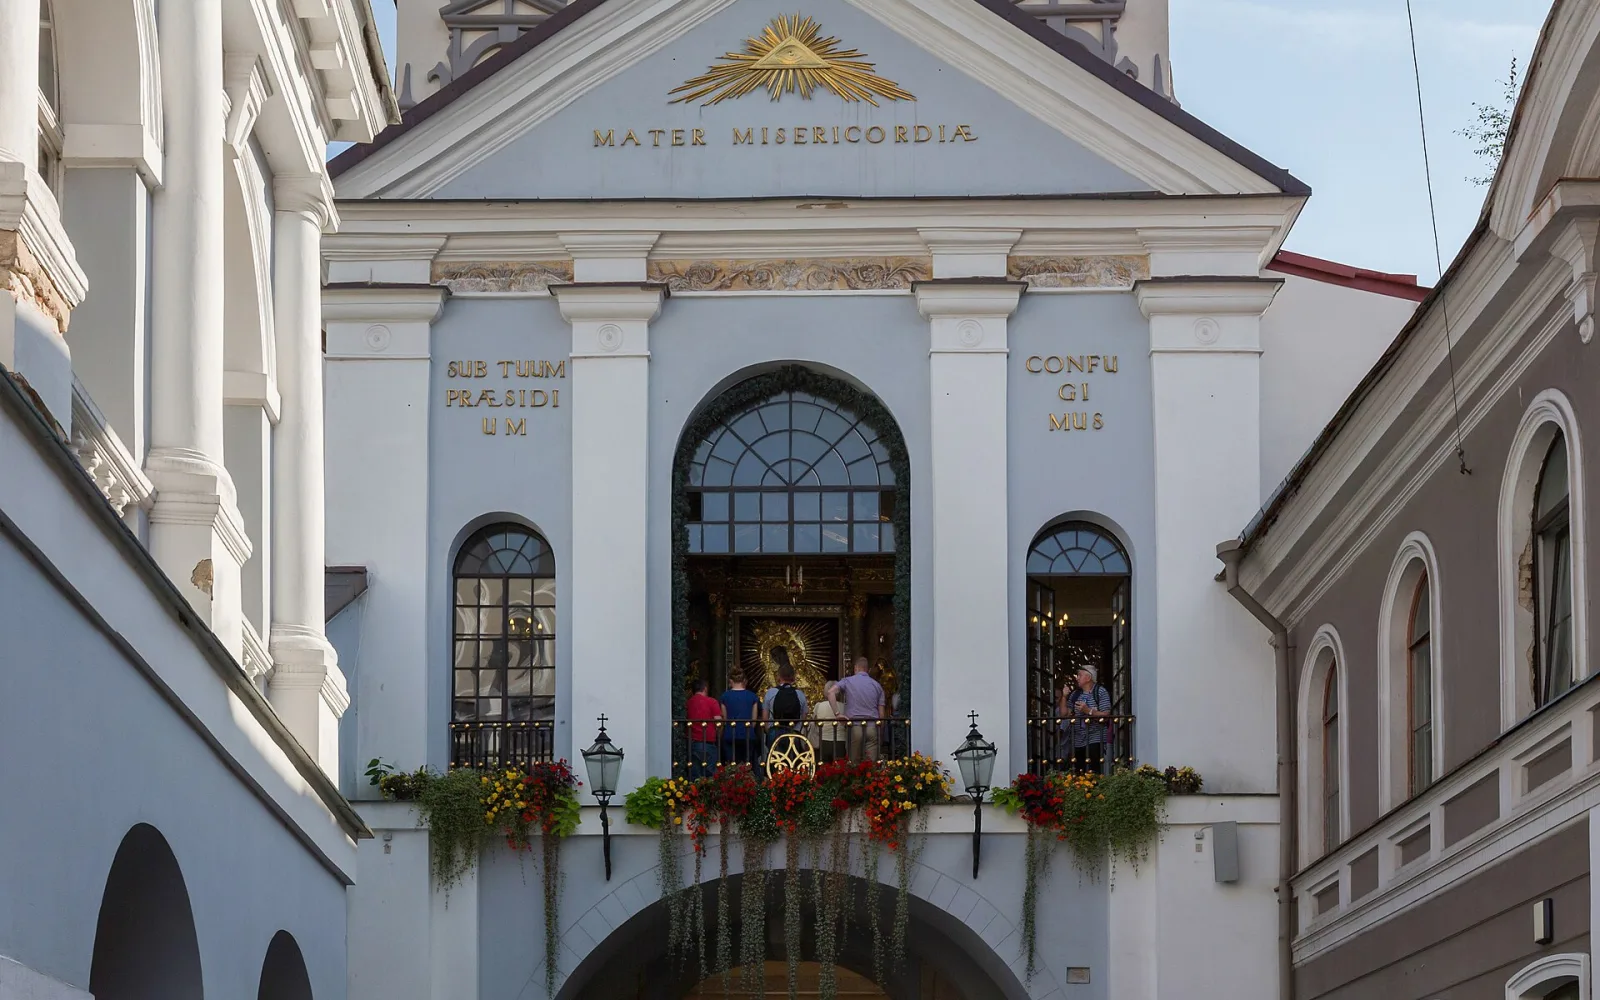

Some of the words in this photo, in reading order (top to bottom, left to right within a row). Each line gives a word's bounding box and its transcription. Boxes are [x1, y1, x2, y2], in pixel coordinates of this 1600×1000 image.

[593, 127, 708, 147] MATER
[447, 360, 488, 378] SUB
[497, 360, 566, 379] TUUM
[1025, 355, 1118, 374] CONFU
[1058, 382, 1090, 402] GI
[482, 417, 527, 436] UM
[1049, 411, 1104, 432] MUS
